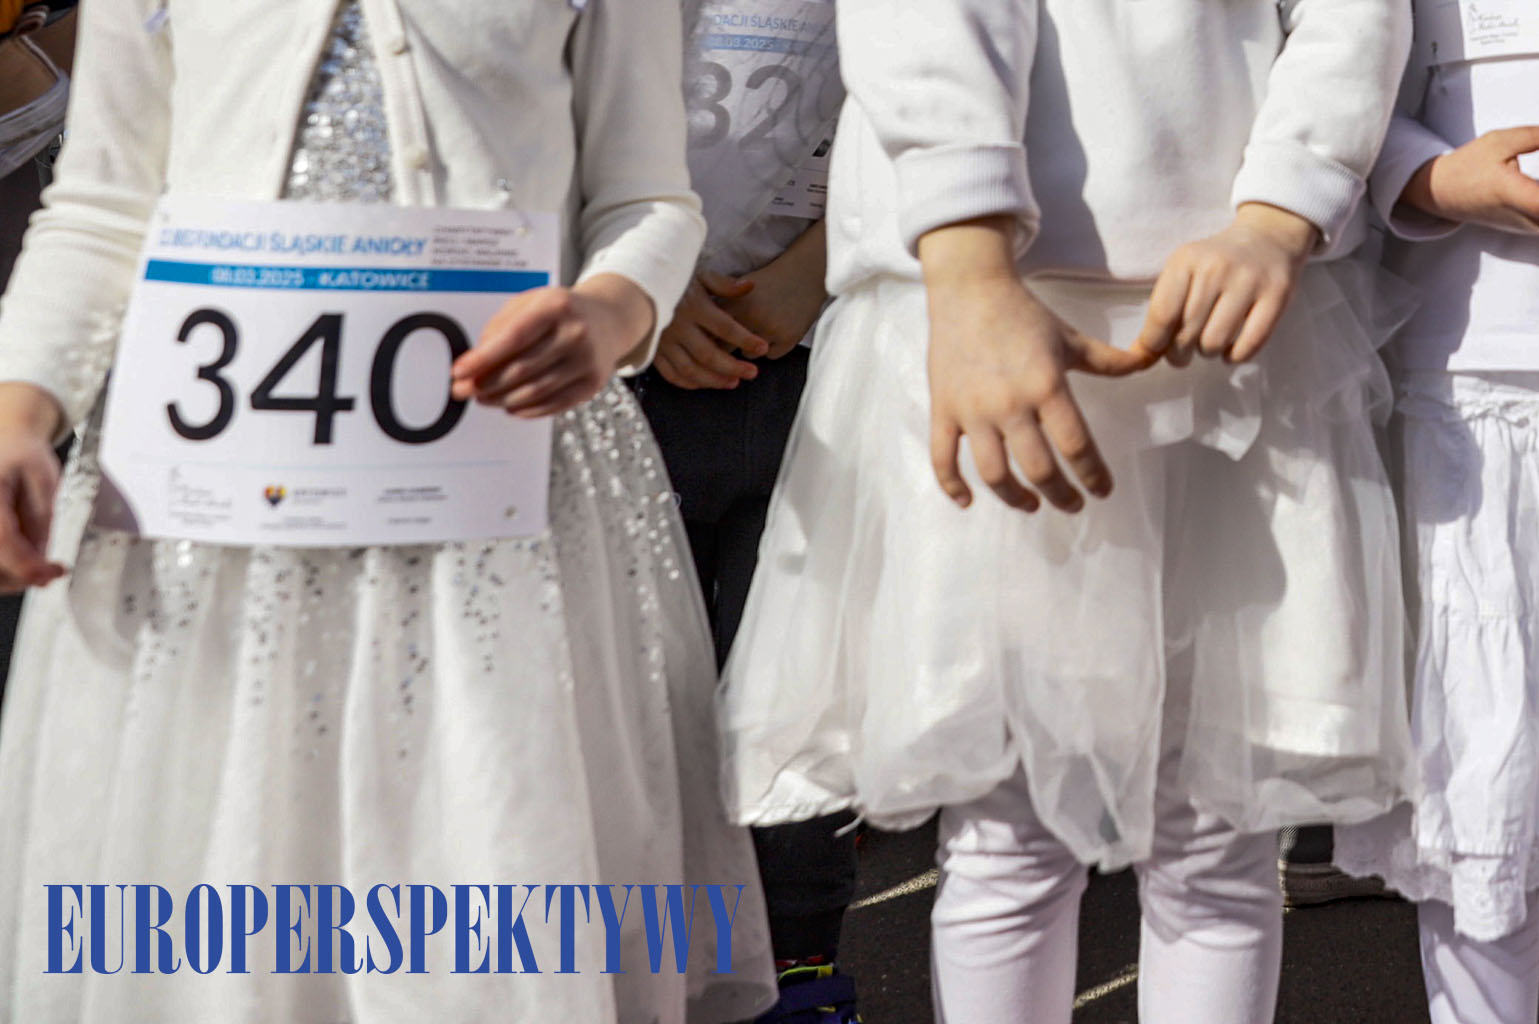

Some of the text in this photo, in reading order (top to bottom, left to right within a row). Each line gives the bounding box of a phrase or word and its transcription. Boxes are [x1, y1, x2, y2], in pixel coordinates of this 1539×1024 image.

[714, 14, 748, 27] DACJI
[690, 61, 832, 154] 32
[270, 230, 346, 255] ŚLĄSKIE
[318, 271, 430, 288] KATOWICE
[167, 309, 472, 444] 340
